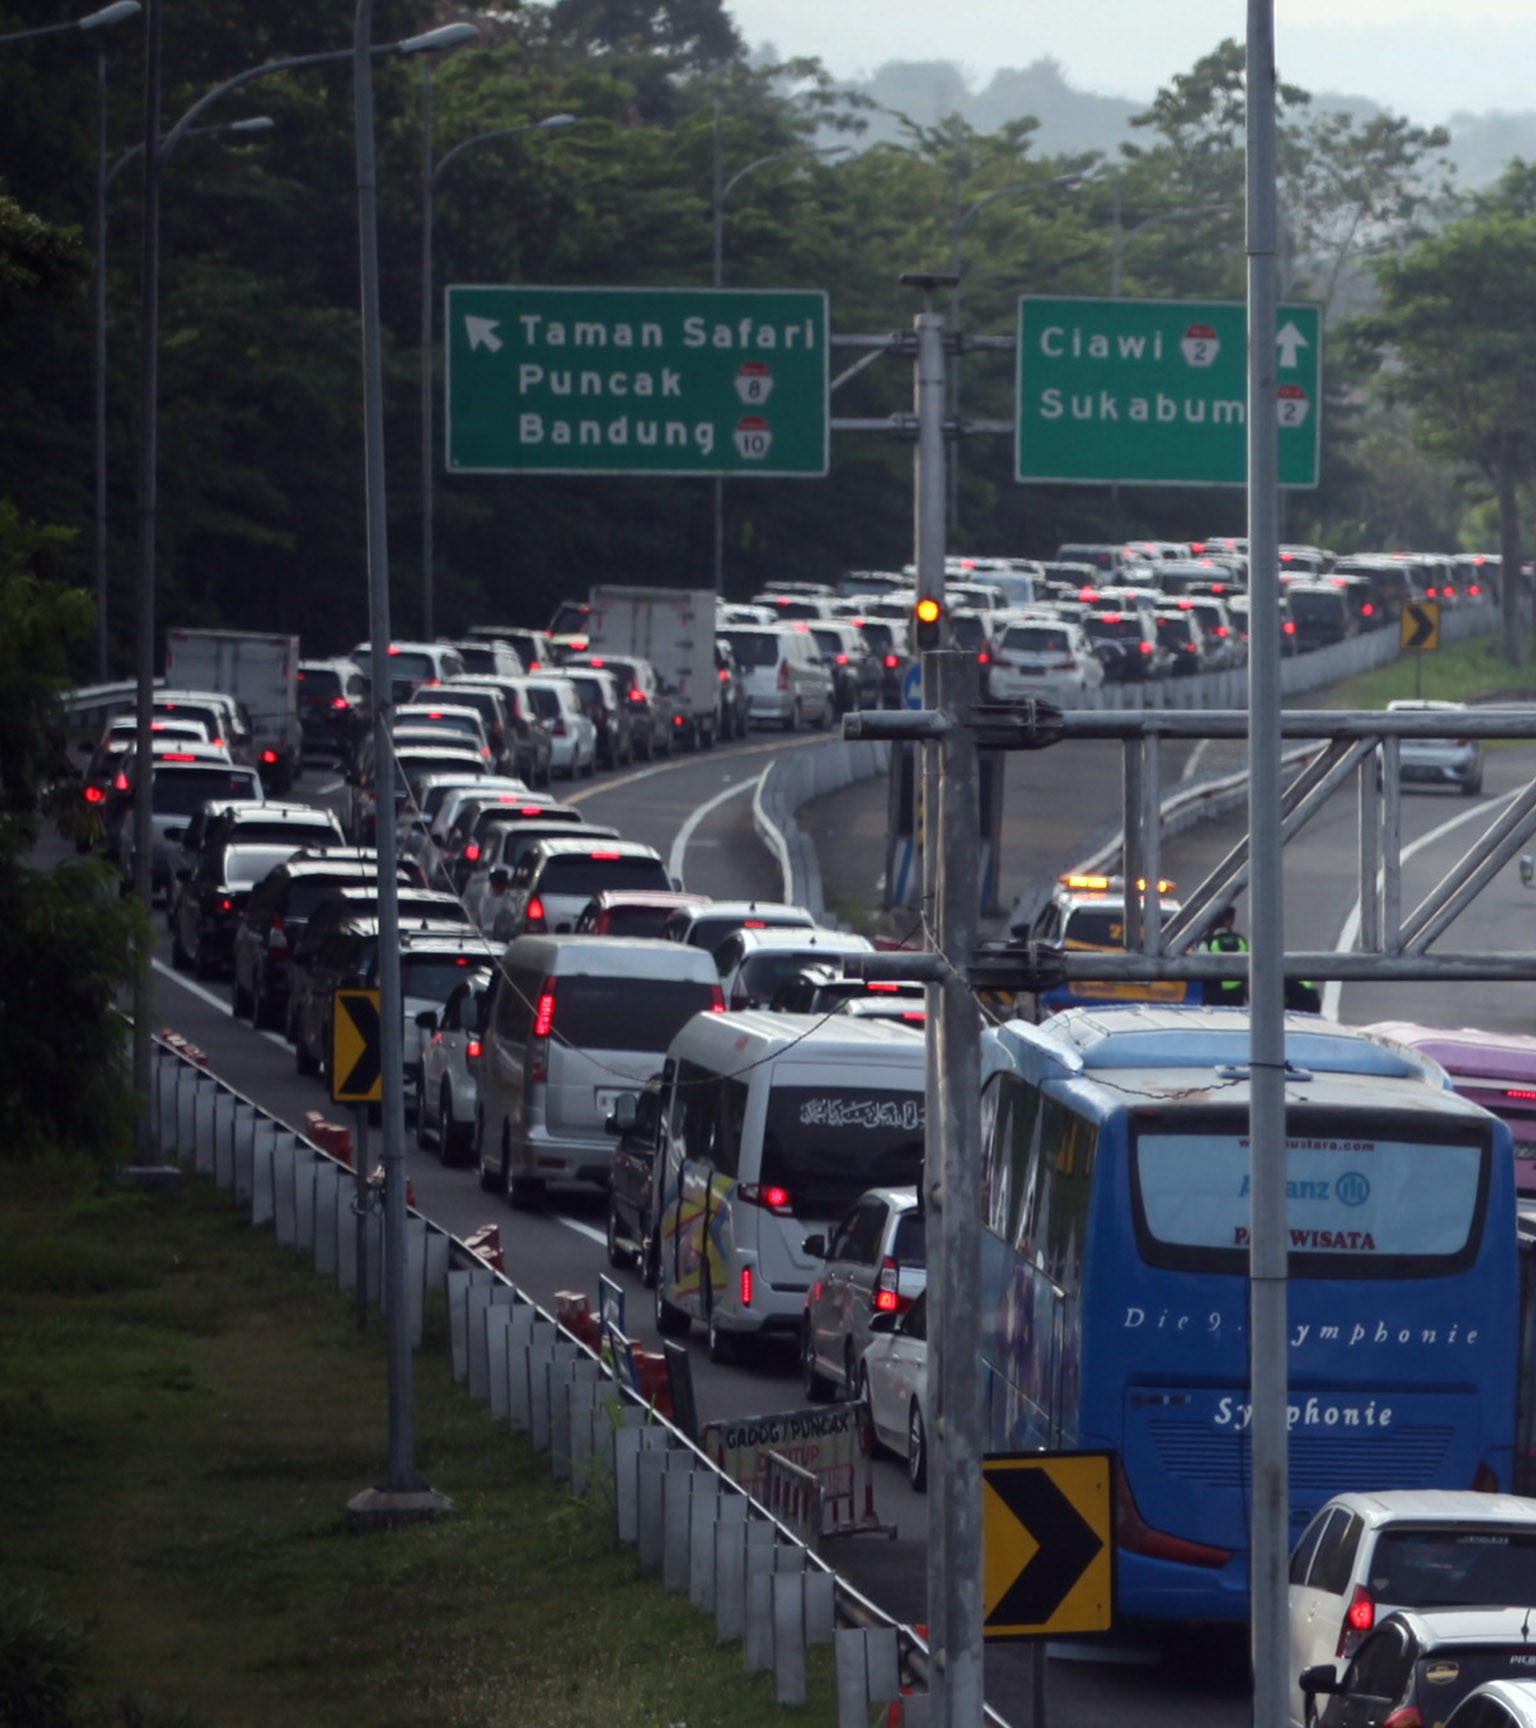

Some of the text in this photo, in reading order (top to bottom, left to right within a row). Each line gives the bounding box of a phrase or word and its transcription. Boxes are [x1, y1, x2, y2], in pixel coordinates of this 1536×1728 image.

[519, 315, 815, 349] Taman Safari
[1039, 326, 1207, 363] Ciawi 2
[519, 364, 761, 399] Puncak 8
[1039, 388, 1297, 425] Sukabum 2
[519, 413, 765, 455] Bandung 10
[1238, 1173, 1330, 1201] Aanz
[1234, 1226, 1376, 1251] PAWISATA
[1124, 1307, 1190, 1330] Die
[1290, 1320, 1478, 1346] ymphonie
[1214, 1396, 1393, 1430] Syphonie
